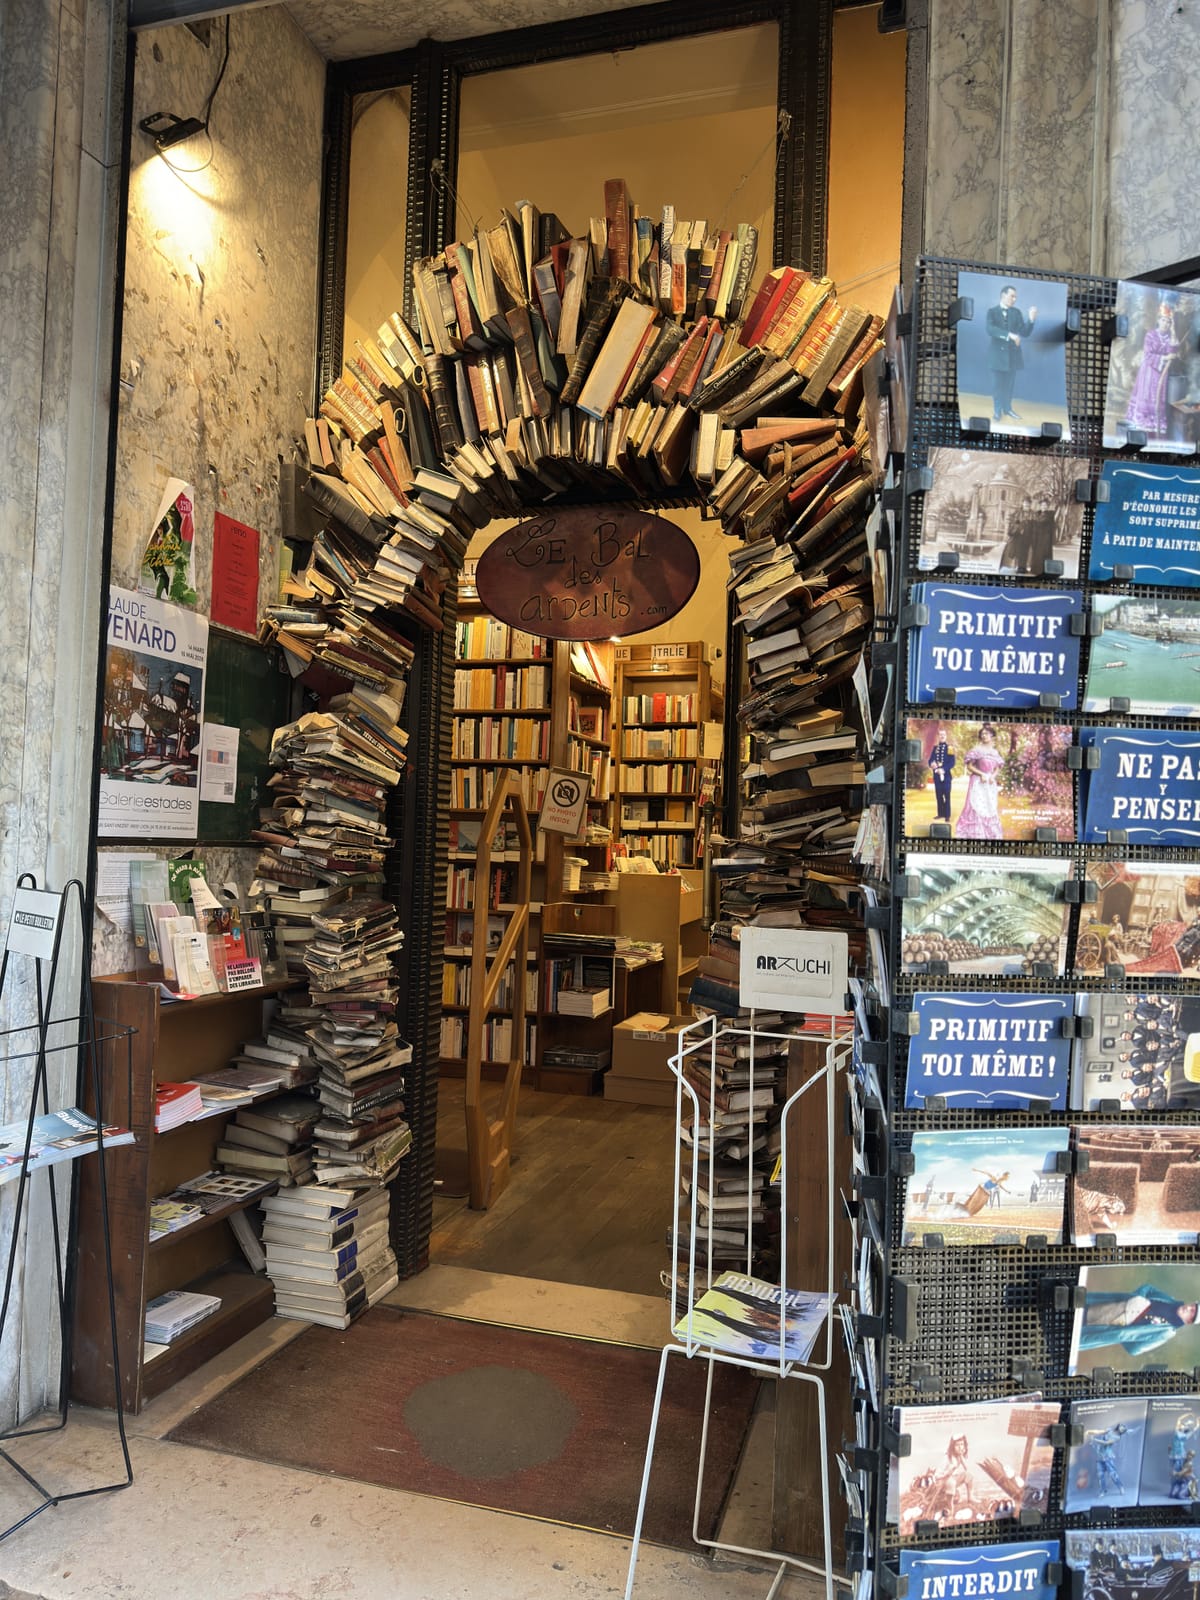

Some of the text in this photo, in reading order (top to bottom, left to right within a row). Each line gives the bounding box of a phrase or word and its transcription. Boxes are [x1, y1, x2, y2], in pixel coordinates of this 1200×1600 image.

[1142, 491, 1200, 504] PAR MESURE
[1122, 500, 1197, 516] D'ÉCONOMIE LES
[1129, 516, 1153, 526] SONT
[1102, 532, 1110, 545] À
[1112, 535, 1137, 547] PATI
[1139, 537, 1154, 548] DE
[564, 554, 602, 589] des
[938, 610, 1063, 639] PRIMITIF
[653, 646, 685, 657] ITALIE
[932, 647, 973, 671] TOI
[1116, 752, 1200, 780] NE PA
[1159, 783, 1168, 796] Y
[557, 809, 577, 818] PHOTO
[928, 1017, 1054, 1042] PRIMITIF
[921, 1054, 963, 1077] TOI
[920, 1568, 1039, 1600] INTERDIT
